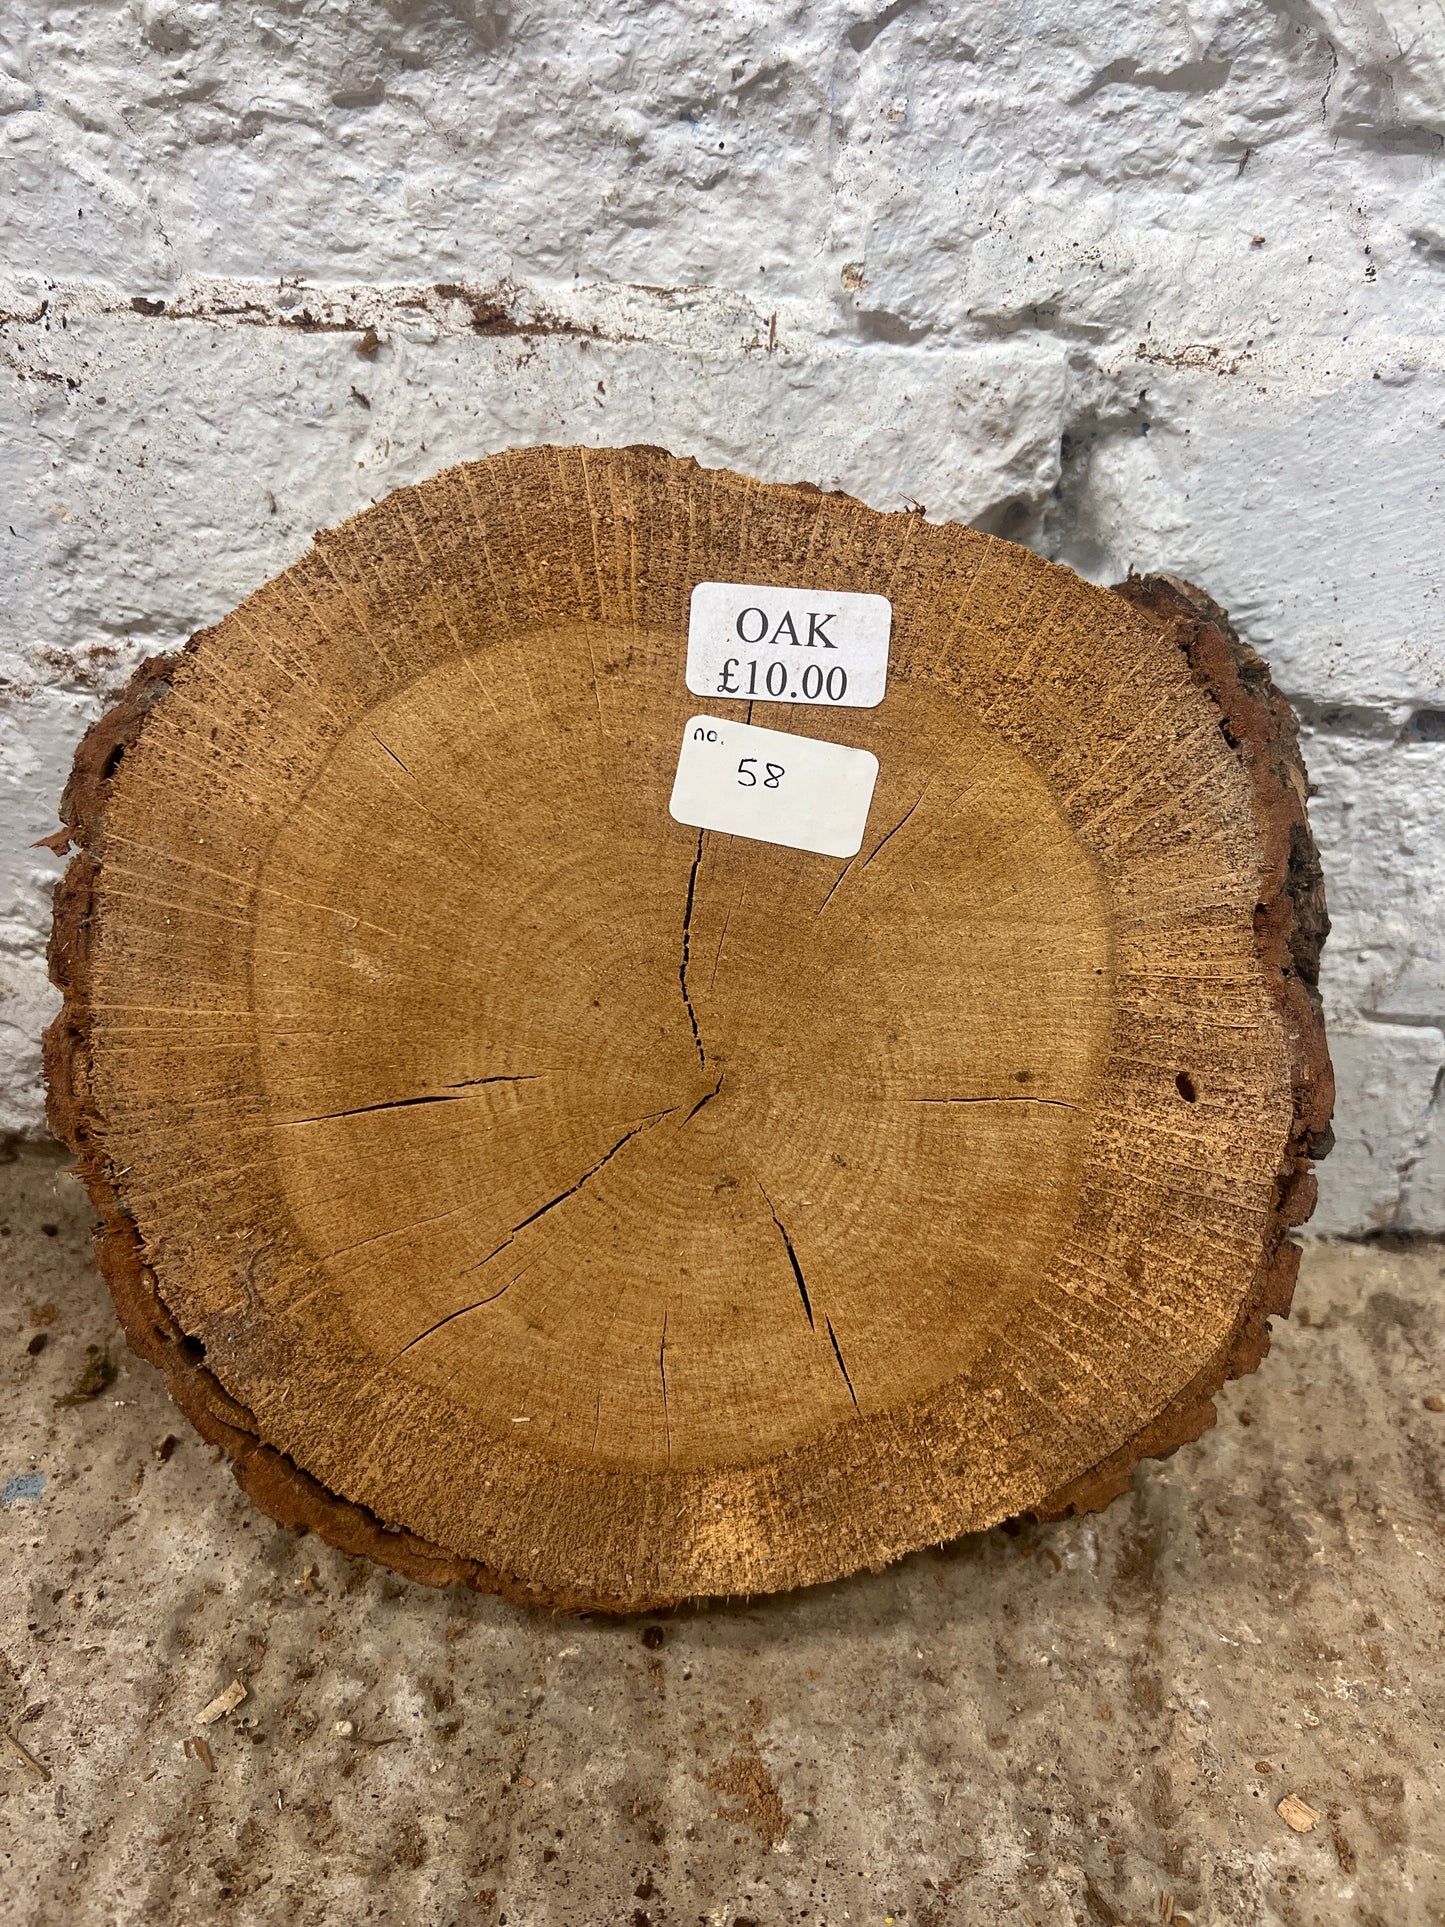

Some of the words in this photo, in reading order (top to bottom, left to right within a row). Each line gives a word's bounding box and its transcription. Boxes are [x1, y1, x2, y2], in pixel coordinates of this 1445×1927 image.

[736, 607, 839, 649] OAK
[717, 658, 848, 701] £10.00
[693, 727, 725, 746] no.
[737, 757, 786, 789] 58
